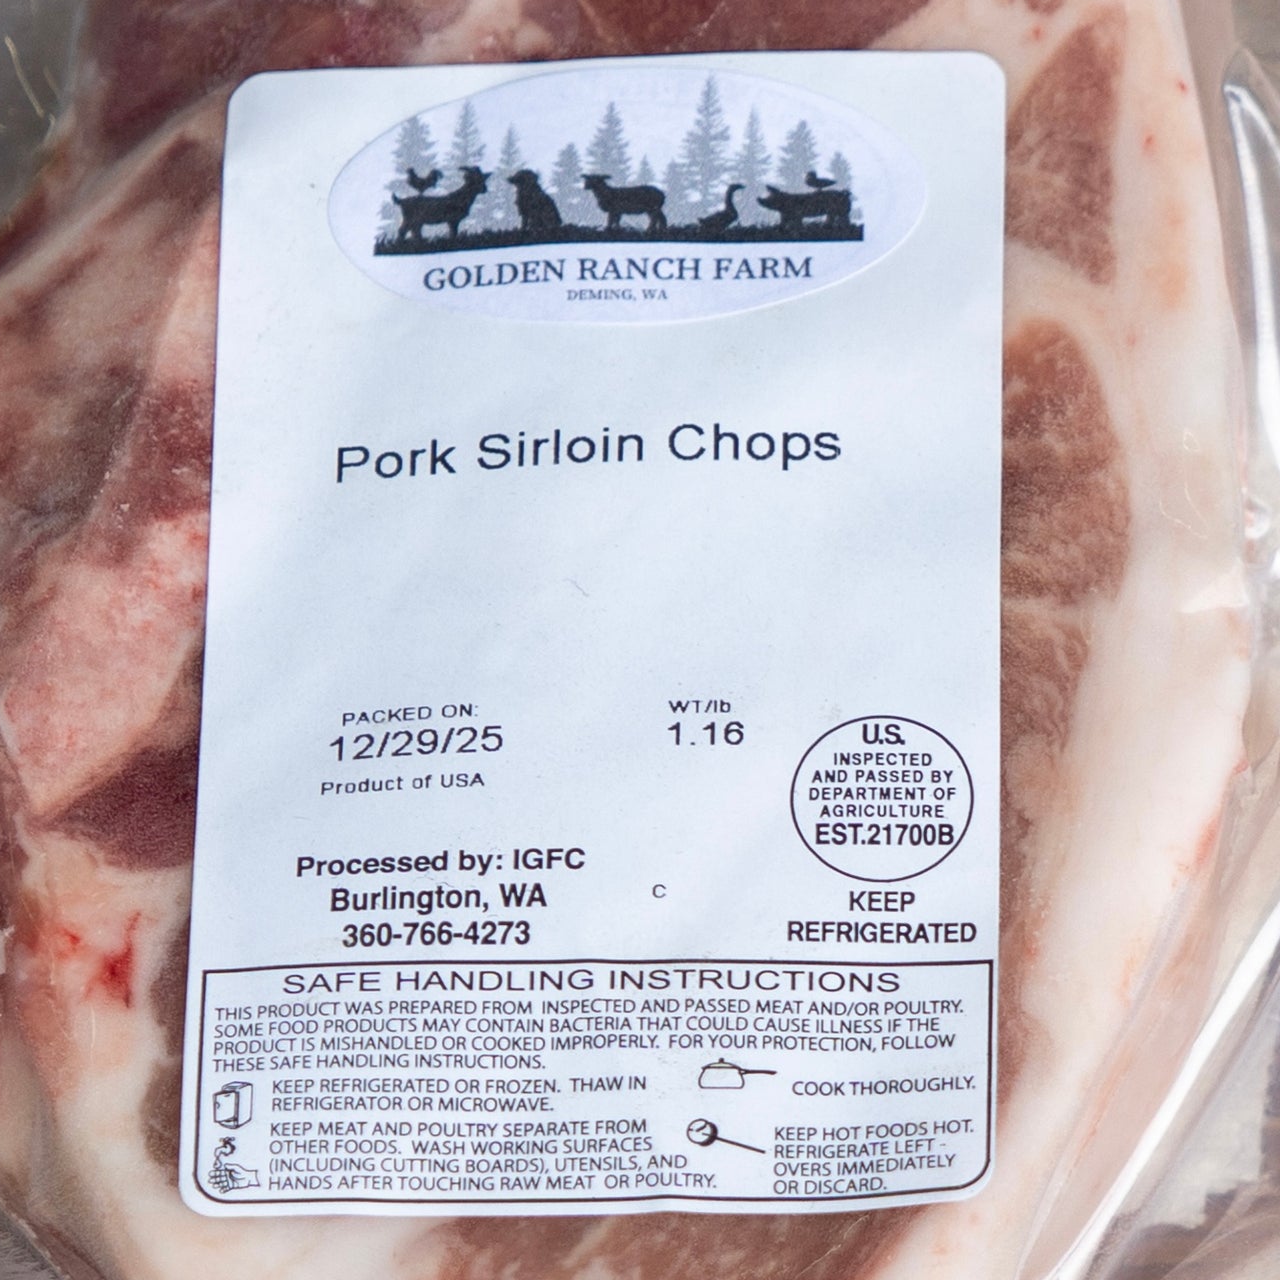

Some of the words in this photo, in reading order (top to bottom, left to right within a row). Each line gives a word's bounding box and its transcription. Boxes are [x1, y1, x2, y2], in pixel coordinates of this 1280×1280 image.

[423, 259, 566, 291] GOLDEN
[577, 257, 702, 282] RANCH
[713, 257, 813, 280] FARM
[567, 289, 637, 302] DEMING,
[642, 289, 668, 300] WA
[336, 439, 458, 483] Pork
[477, 427, 646, 471] Sirloin
[668, 423, 842, 471] Chops
[342, 707, 432, 726] PACKED
[441, 704, 479, 718] ON:
[668, 700, 731, 713] WT/lb
[329, 726, 504, 761] 12/29/25
[668, 722, 745, 746] 1.16
[862, 724, 906, 745] U.S.
[833, 753, 932, 767] INSPECTED
[321, 777, 404, 796] Product
[412, 775, 432, 789] of
[441, 773, 485, 788] USA
[812, 771, 848, 783] AND
[855, 771, 923, 783] PASSED
[931, 771, 954, 783] BY
[809, 788, 927, 801] DEPARTMENT
[933, 788, 957, 801] OF
[820, 805, 944, 818] AGRICULTURE
[815, 823, 955, 845] EST.21700B
[297, 851, 449, 877] Processed
[459, 850, 503, 876] by:
[513, 848, 586, 870] IGFC
[330, 886, 489, 915] Burlington,
[499, 883, 548, 907] WA
[652, 884, 667, 898] C
[849, 891, 915, 912] KEEP
[342, 921, 531, 948] 360-766-4273
[788, 921, 977, 943] REFRIGERATED
[283, 972, 381, 994] SAFE
[396, 969, 594, 991] HANDLING
[610, 970, 900, 992] INSTRUCTIONS
[215, 1007, 252, 1020] THIS
[257, 1002, 340, 1018] PRODUCT
[344, 1001, 384, 1015] WAS
[389, 1001, 477, 1015] PREPARED
[482, 1001, 532, 1015] FROM
[542, 999, 636, 1014] INSPECTED
[641, 999, 680, 1014] AND
[685, 999, 751, 1014] PASSED
[756, 1000, 804, 1014] MEAT
[808, 1001, 879, 1016] AND/OR
[884, 999, 964, 1015] POULTRY.
[214, 1023, 264, 1038] SOME
[269, 1021, 318, 1036] FOOD
[324, 1018, 417, 1033] PRODUCTS
[422, 1019, 461, 1033] MAY
[465, 1018, 545, 1033] CONTAIN
[550, 1017, 632, 1033] BACTERIA
[635, 1017, 681, 1031] THAT
[686, 1017, 749, 1032] COULD
[753, 1018, 810, 1033] CAUSE
[815, 1020, 883, 1034] ILLNESS
[888, 1020, 904, 1033] IF
[907, 1018, 940, 1032] THE
[214, 1039, 296, 1055] PRODUCT
[301, 1038, 315, 1051] IS
[320, 1036, 437, 1051] MISHANDLED
[441, 1036, 467, 1051] OR
[471, 1036, 545, 1051] COOKED
[551, 1035, 659, 1051] IMPROPERLY.
[669, 1035, 703, 1049] FOR
[707, 1035, 757, 1049] YOUR
[762, 1036, 876, 1053] PROTECTION,
[881, 1034, 955, 1050] FOLLOW
[213, 1058, 265, 1072] THESE
[270, 1055, 312, 1070] SAFE
[317, 1054, 409, 1068] HANDLING
[415, 1054, 545, 1069] INSTRUCTIONS.
[273, 1080, 315, 1094] KEEP
[320, 1078, 449, 1093] REFRIGERATED
[454, 1079, 481, 1093] OR
[485, 1079, 561, 1093] FROZEN.
[570, 1077, 625, 1092] THAW
[628, 1076, 646, 1090] IN
[792, 1081, 845, 1096] COOK
[849, 1076, 976, 1095] THOROUGHLY.
[272, 1097, 403, 1111] REFRIGERATOR
[408, 1097, 433, 1111] OR
[438, 1097, 554, 1112] MICROWAVE.
[270, 1122, 313, 1136] KEEP
[318, 1122, 368, 1136] MEAT
[372, 1122, 412, 1136] AND
[418, 1122, 498, 1137] POULTRY
[503, 1121, 590, 1137] SEPARATE
[595, 1119, 646, 1134] FROM
[774, 1126, 818, 1141] KEEP
[822, 1126, 860, 1140] HOT
[865, 1122, 929, 1139] FOODS
[933, 1119, 974, 1134] HOT.
[269, 1140, 330, 1154] OTHER
[335, 1140, 401, 1154] FOODS.
[412, 1140, 467, 1154] WASH
[471, 1140, 558, 1154] WORKING
[562, 1137, 653, 1153] SURFACES
[774, 1143, 889, 1158] REFRIGERATE
[270, 1158, 376, 1174] (INCLUDING
[380, 1158, 461, 1172] CUTTING
[466, 1157, 549, 1176] BOARDS),
[554, 1156, 642, 1172] UTENSILS,
[647, 1155, 687, 1169] AND
[774, 1162, 832, 1176] OVERS
[837, 1155, 955, 1175] IMMEDIATELY
[269, 1176, 332, 1190] HANDS
[337, 1175, 393, 1190] AFTER
[398, 1176, 496, 1190] TOUCHING
[500, 1176, 543, 1190] RAW
[545, 1175, 596, 1190] MEAT
[604, 1174, 630, 1189] OR
[636, 1174, 717, 1188] POULTRY.
[773, 1180, 799, 1195] OR
[804, 1177, 887, 1193] DISCARD.
